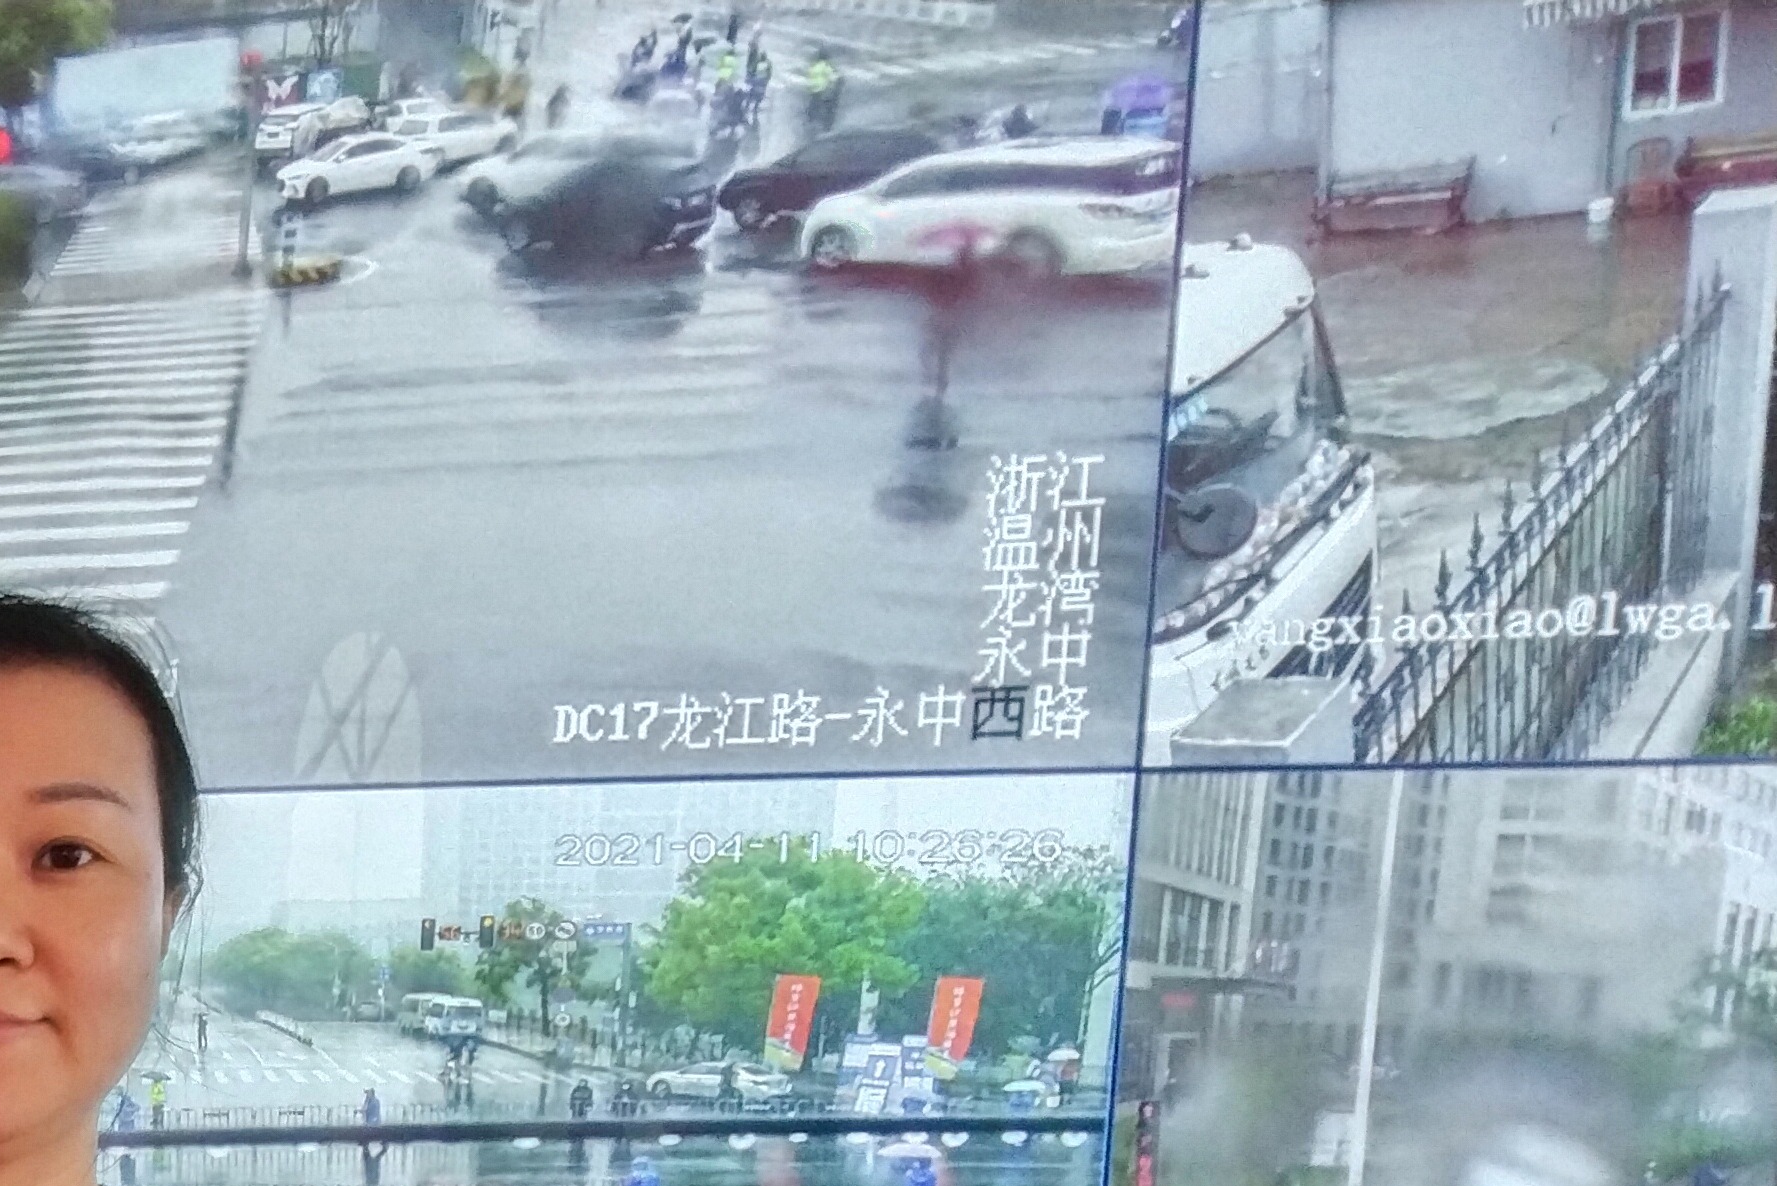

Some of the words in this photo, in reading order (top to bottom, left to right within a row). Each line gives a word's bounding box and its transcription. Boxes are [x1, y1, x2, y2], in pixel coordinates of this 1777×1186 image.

[986, 450, 1107, 521] 浙江
[982, 504, 1103, 572] 温州
[979, 568, 1101, 629] 龙湾
[971, 622, 1092, 688] 永中
[552, 684, 1090, 752] DC17龙江路-永中西路
[554, 831, 822, 867] 2021-04-11
[851, 829, 1064, 865] 10:26:26
